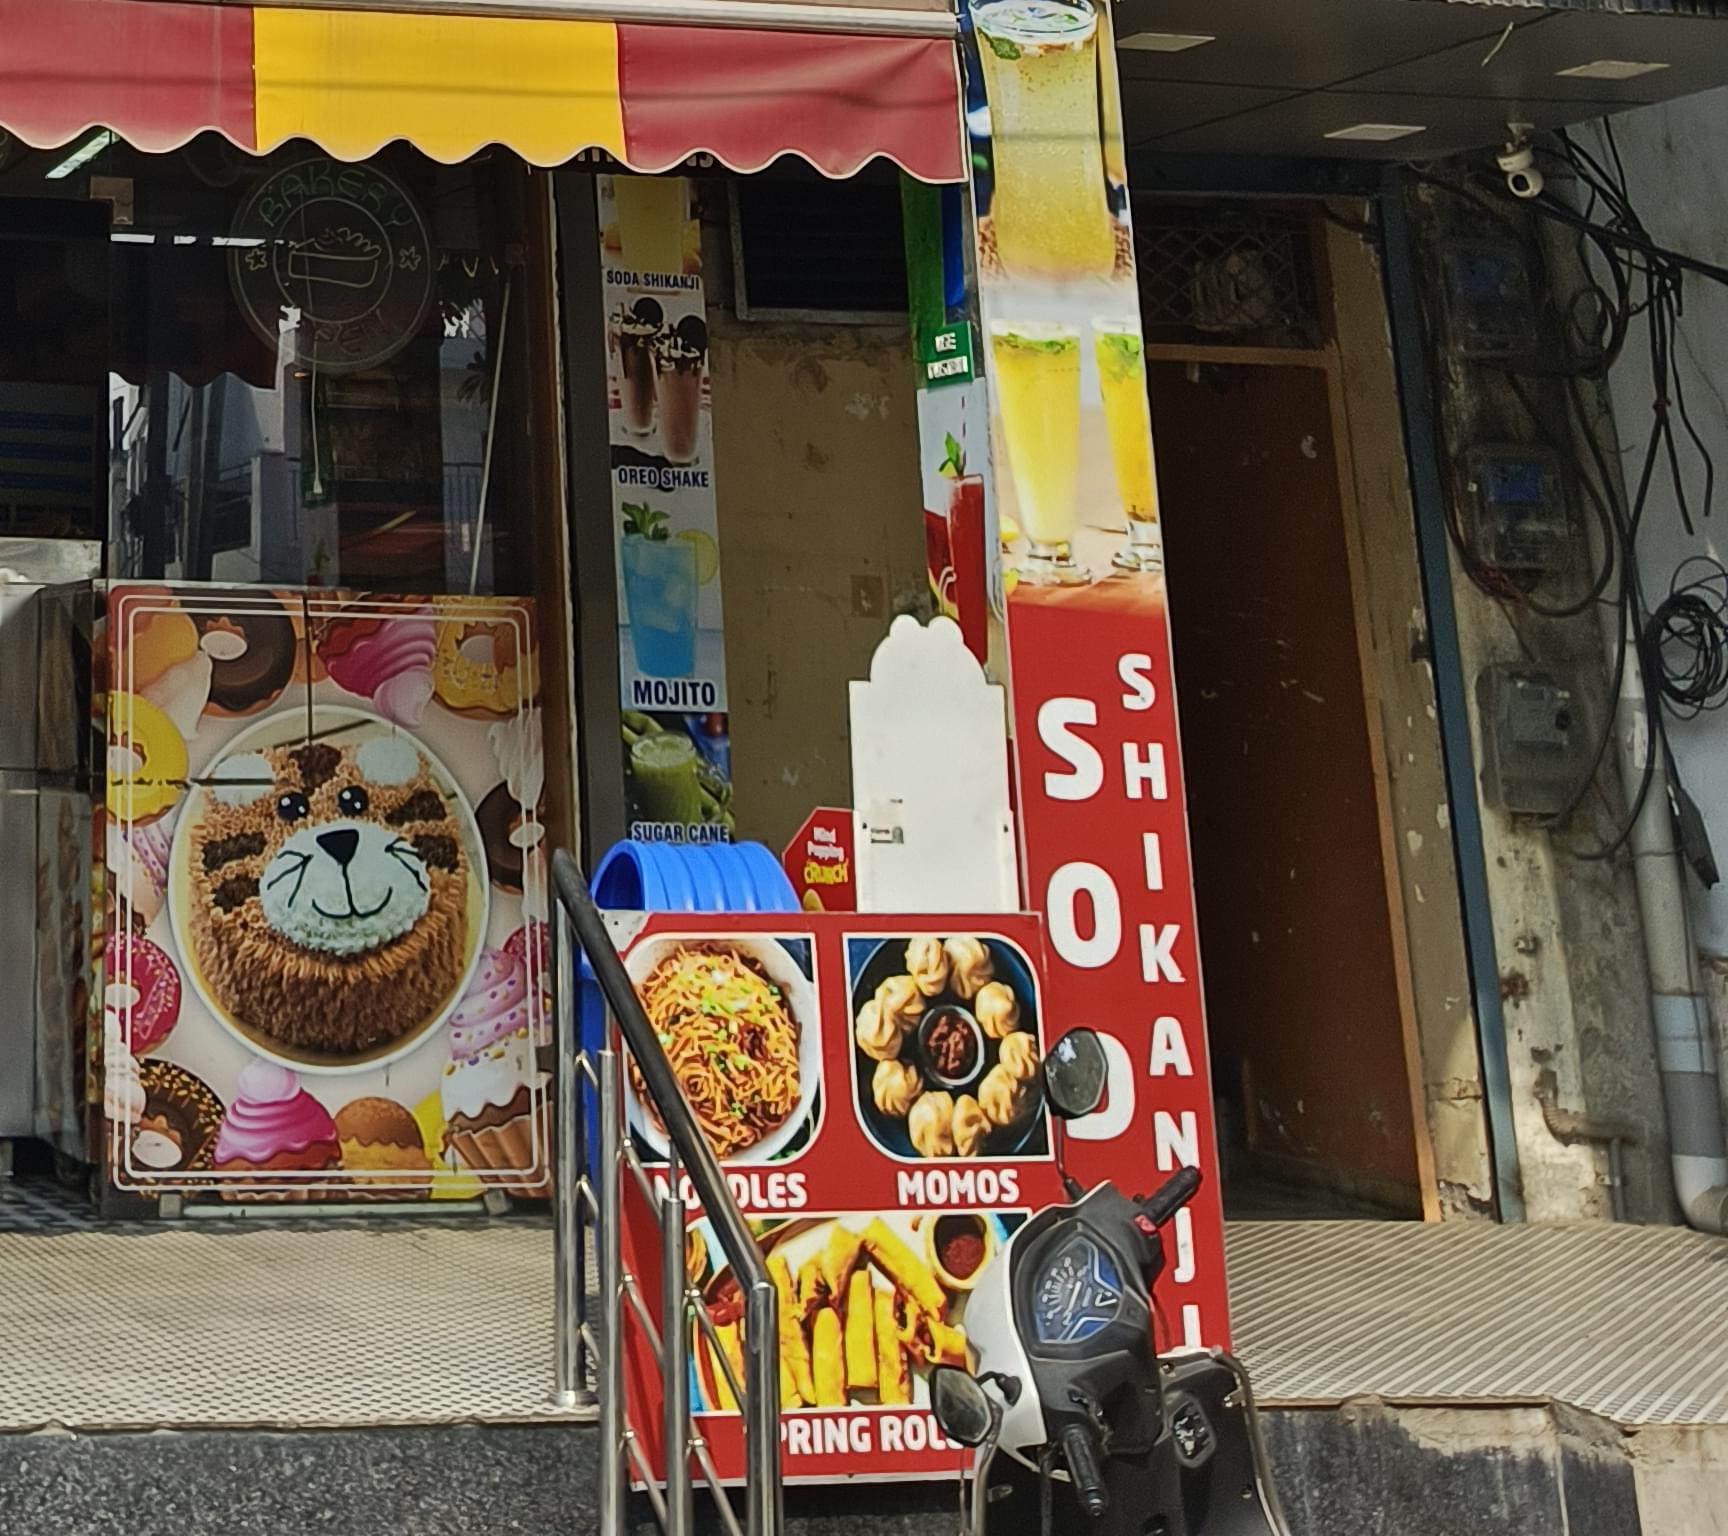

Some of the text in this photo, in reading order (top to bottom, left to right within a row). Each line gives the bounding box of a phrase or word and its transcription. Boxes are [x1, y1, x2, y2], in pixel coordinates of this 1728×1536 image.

[605, 269, 702, 292] SODA SHIKANJI
[633, 679, 717, 707] MOJITO
[655, 1173, 808, 1209] NODLES
[897, 1170, 1019, 1204] MOMOS
